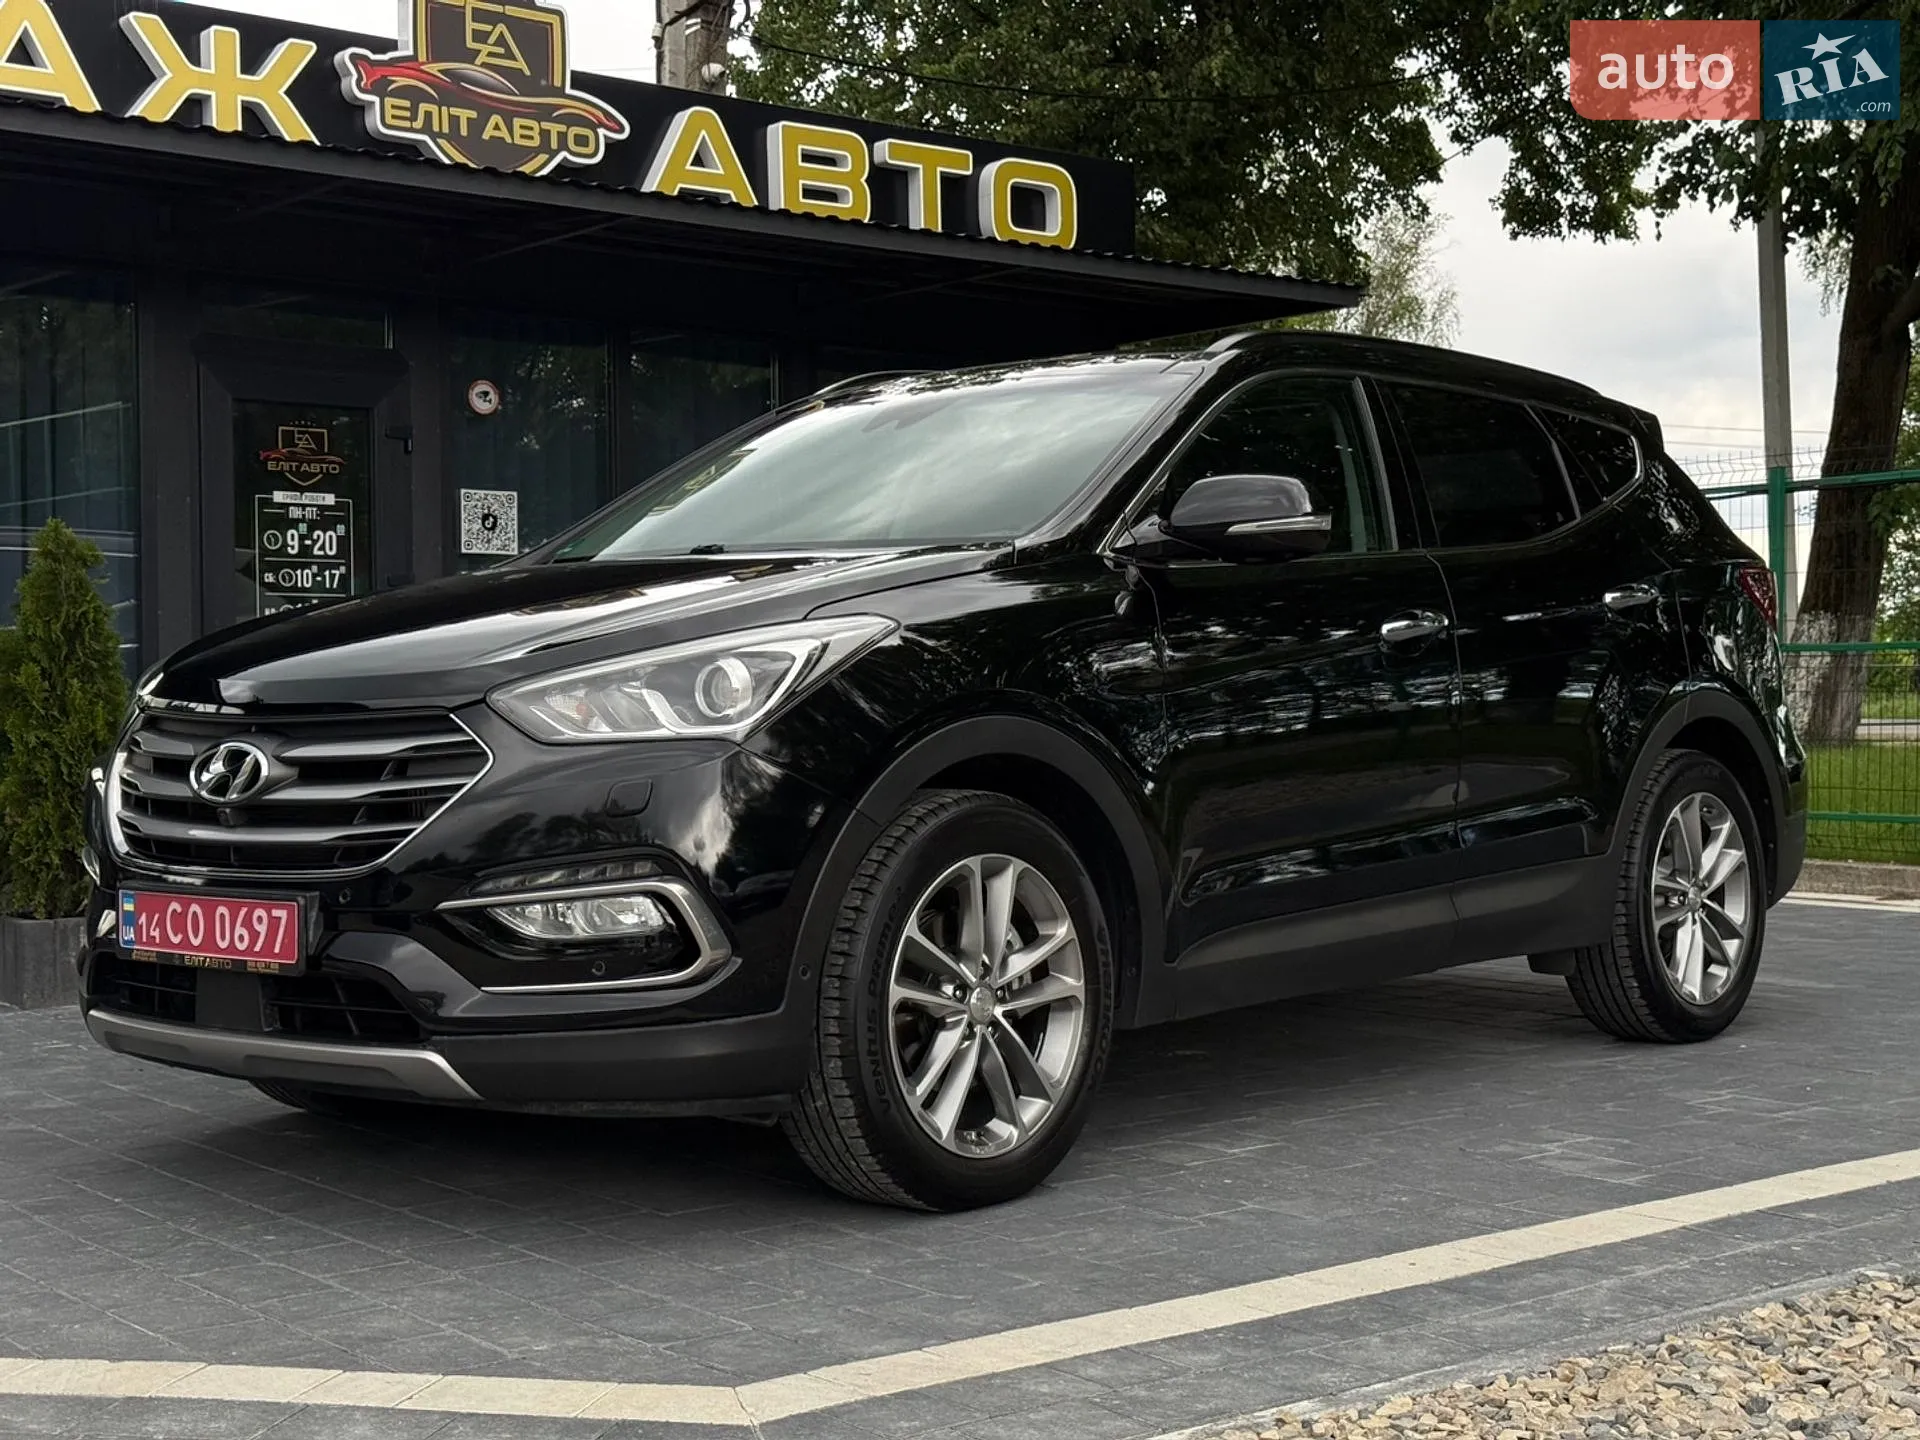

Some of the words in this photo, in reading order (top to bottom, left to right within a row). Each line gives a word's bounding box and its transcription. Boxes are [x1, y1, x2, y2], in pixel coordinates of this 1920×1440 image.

[384, 96, 478, 137] ЕЛІТ
[481, 113, 597, 155] АВТО
[641, 105, 1078, 250] АВТО
[267, 461, 300, 473] ЕЛІТ
[300, 462, 341, 475] АВТО
[122, 924, 136, 941] UA
[215, 904, 288, 954] 0697
